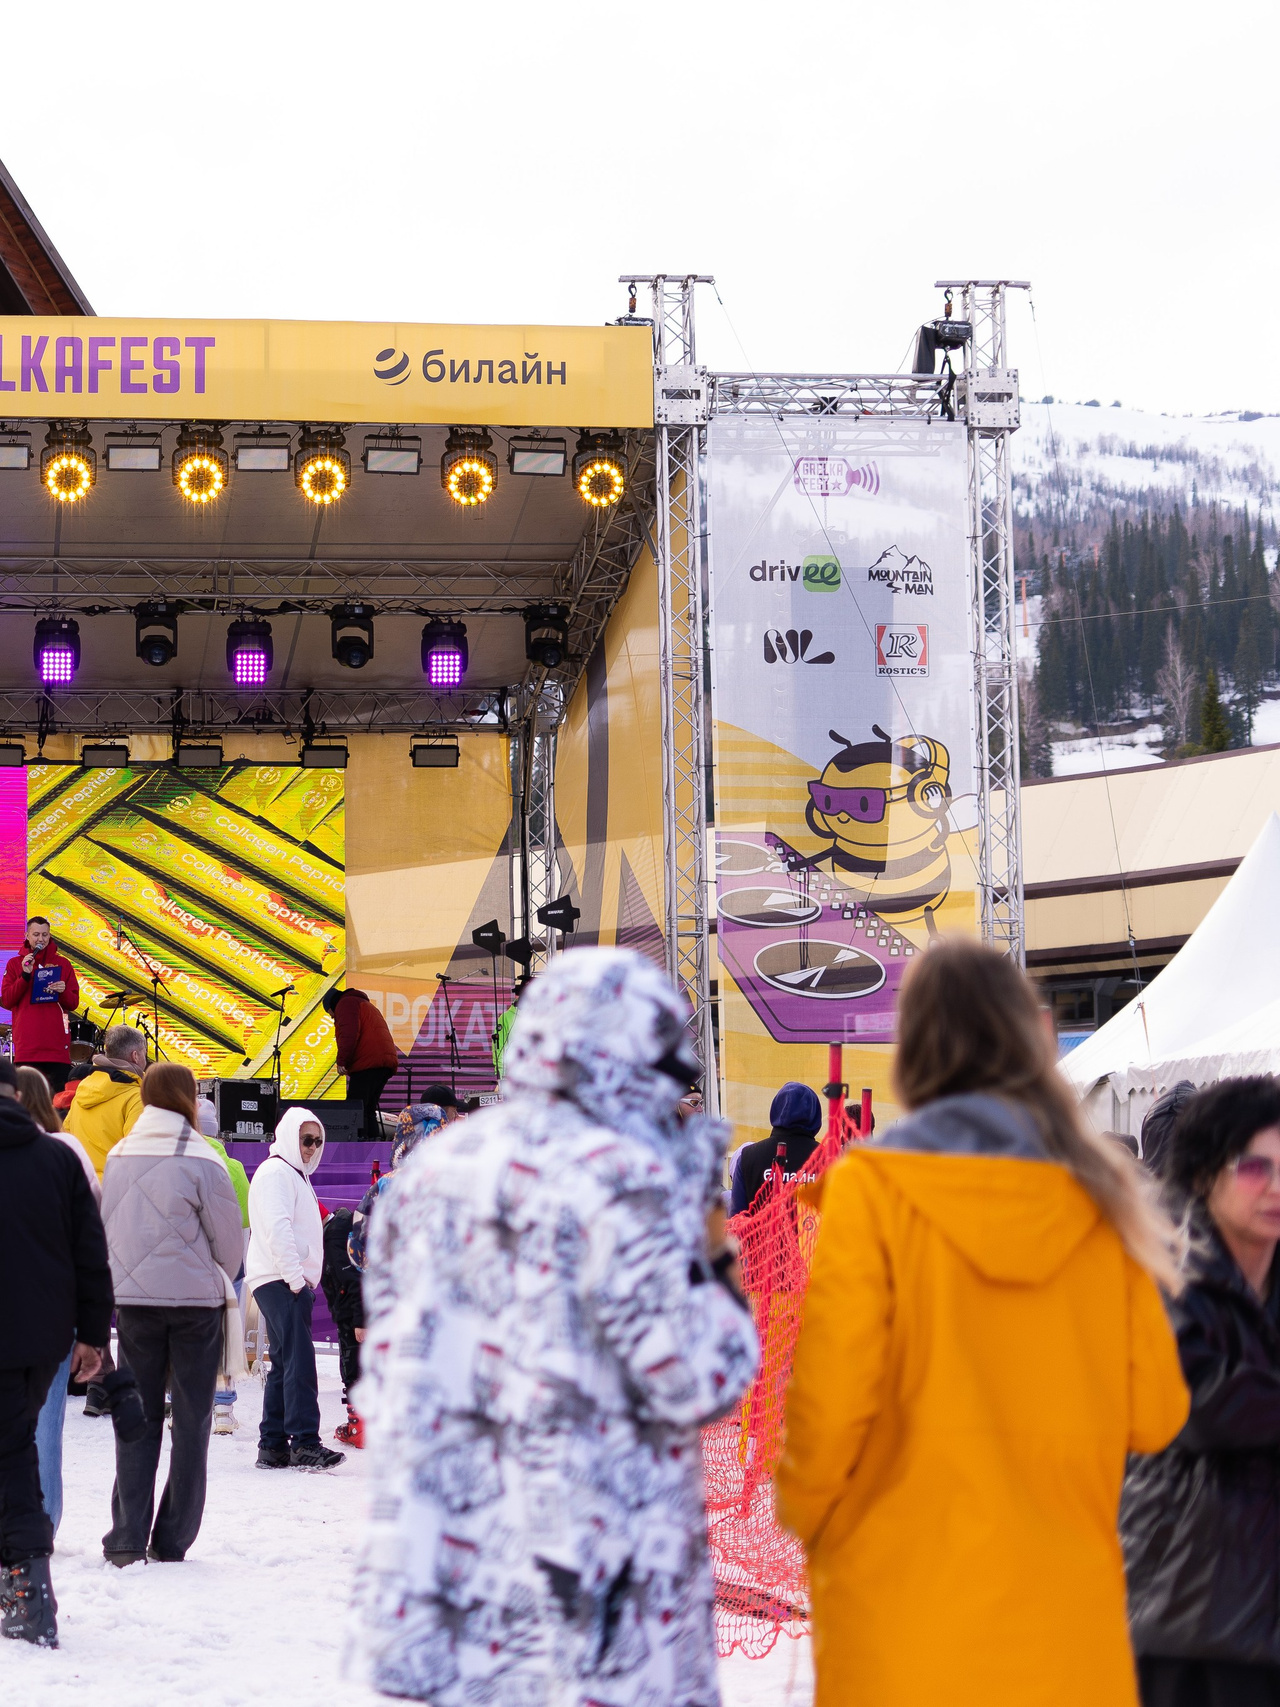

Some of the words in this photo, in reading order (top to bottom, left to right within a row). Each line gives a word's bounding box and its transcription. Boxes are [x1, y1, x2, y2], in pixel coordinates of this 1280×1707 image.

[422, 349, 567, 385] билайн
[802, 462, 844, 477] GRELKA
[802, 477, 830, 491] FEST
[749, 559, 841, 586] drivee
[868, 569, 932, 583] MOUNTAIN
[905, 583, 934, 595] MAN
[878, 667, 927, 675] ROSTIC'S
[61, 767, 120, 810] Peptide
[215, 815, 288, 860] Collagen
[288, 855, 345, 892] Peptid
[181, 853, 255, 898] Collagen
[255, 892, 334, 943] Peptides
[141, 887, 215, 936] Collagen
[215, 930, 294, 985] Peptides
[97, 929, 173, 978] Collagen
[174, 972, 255, 1027] Peptides
[763, 1168, 816, 1183] блайн
